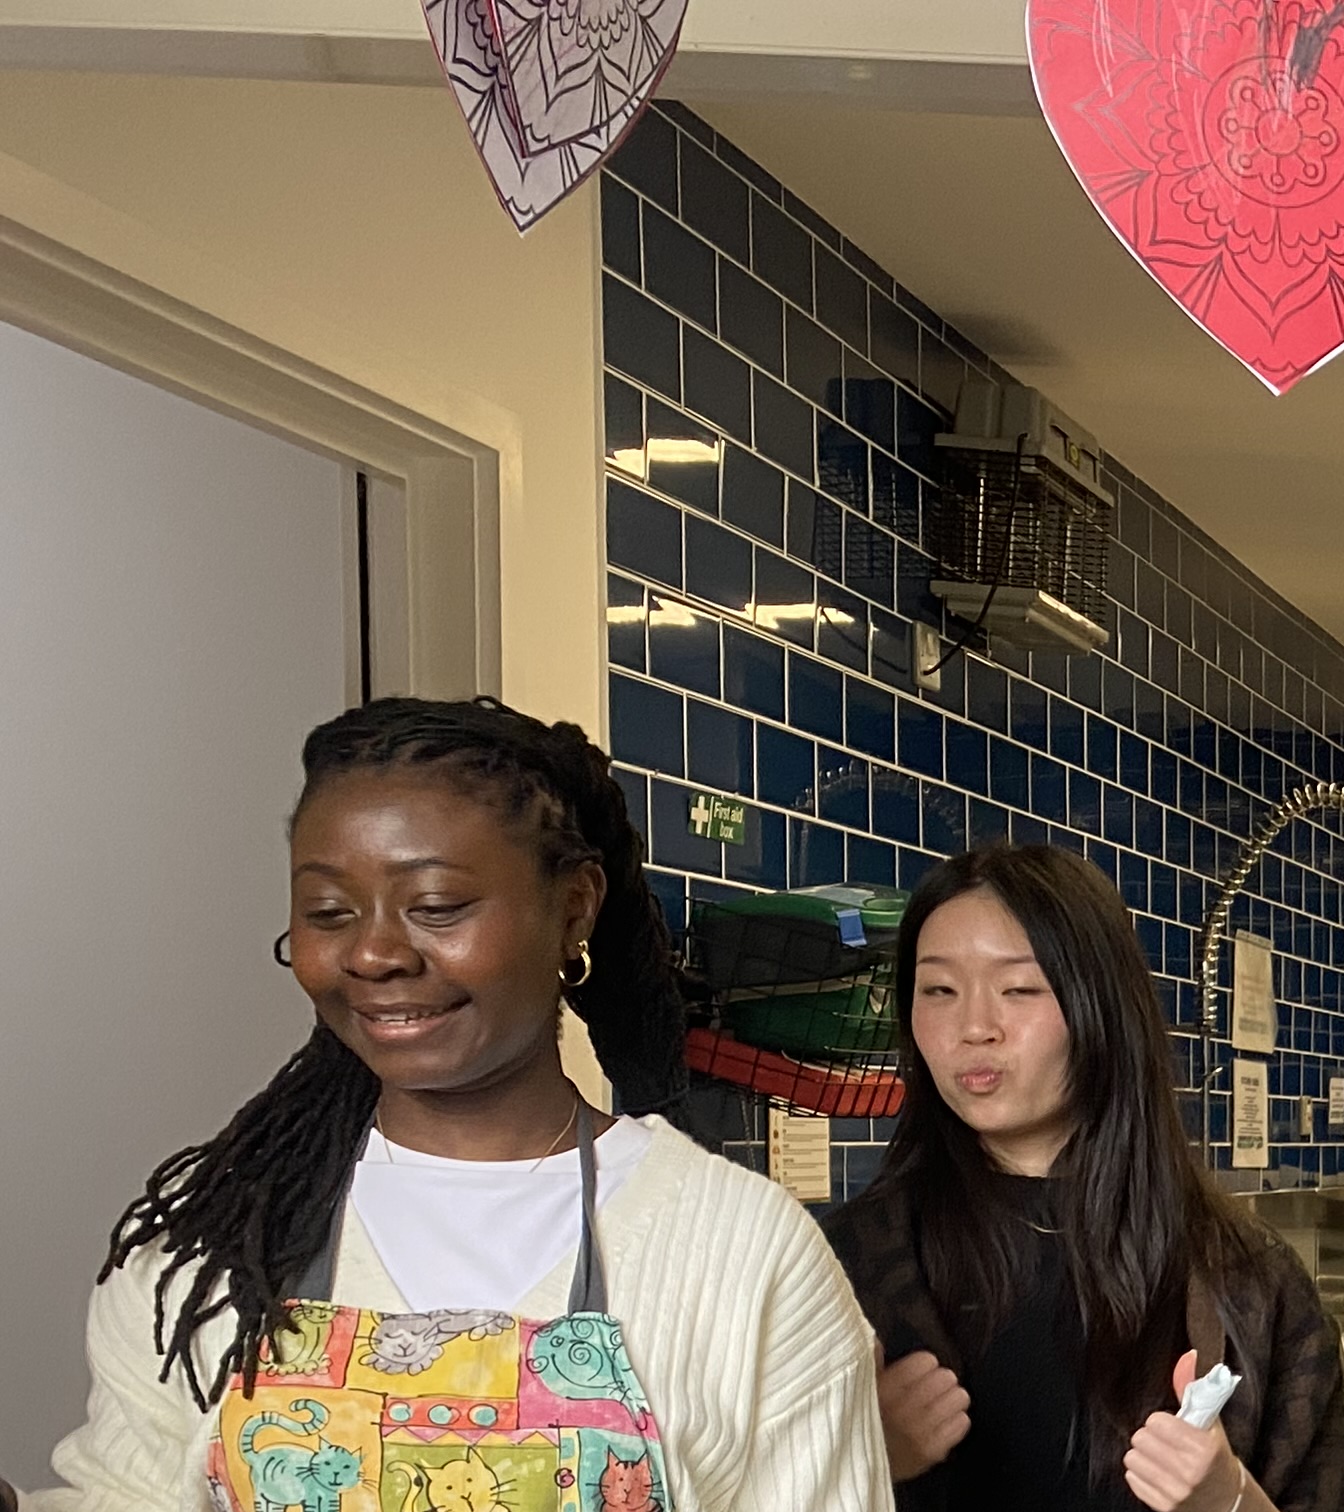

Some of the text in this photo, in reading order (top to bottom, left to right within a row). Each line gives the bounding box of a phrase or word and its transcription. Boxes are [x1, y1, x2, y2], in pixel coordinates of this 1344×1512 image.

[713, 802, 744, 823] First aid
[719, 821, 734, 839] box
